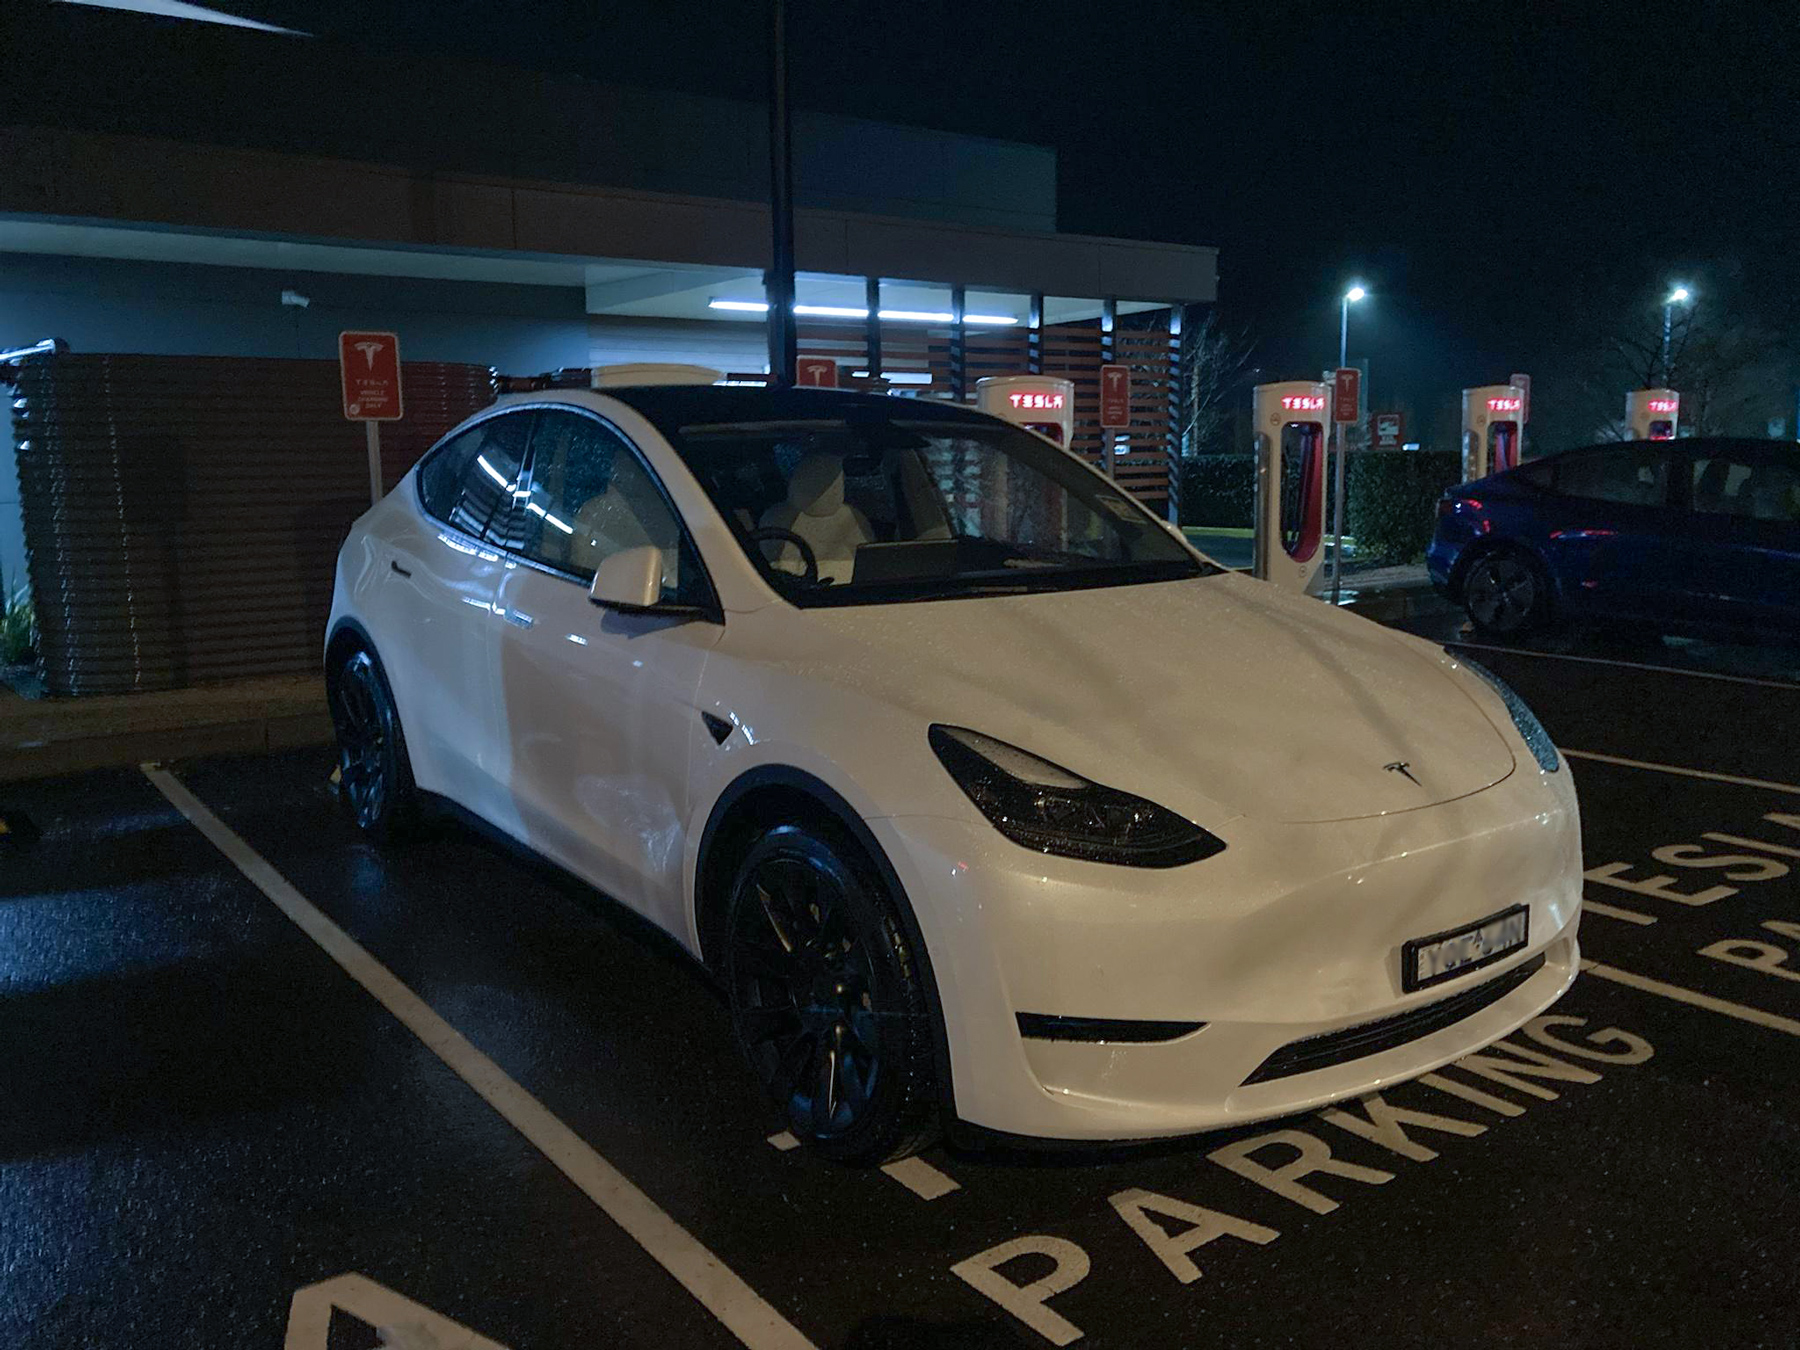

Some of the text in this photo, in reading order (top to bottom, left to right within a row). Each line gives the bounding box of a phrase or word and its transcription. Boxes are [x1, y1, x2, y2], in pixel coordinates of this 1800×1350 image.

[1009, 393, 1064, 409] TESLA
[1282, 397, 1325, 410] TESLA
[1488, 399, 1521, 410] TESLA
[950, 1013, 1655, 1348] PARKING
